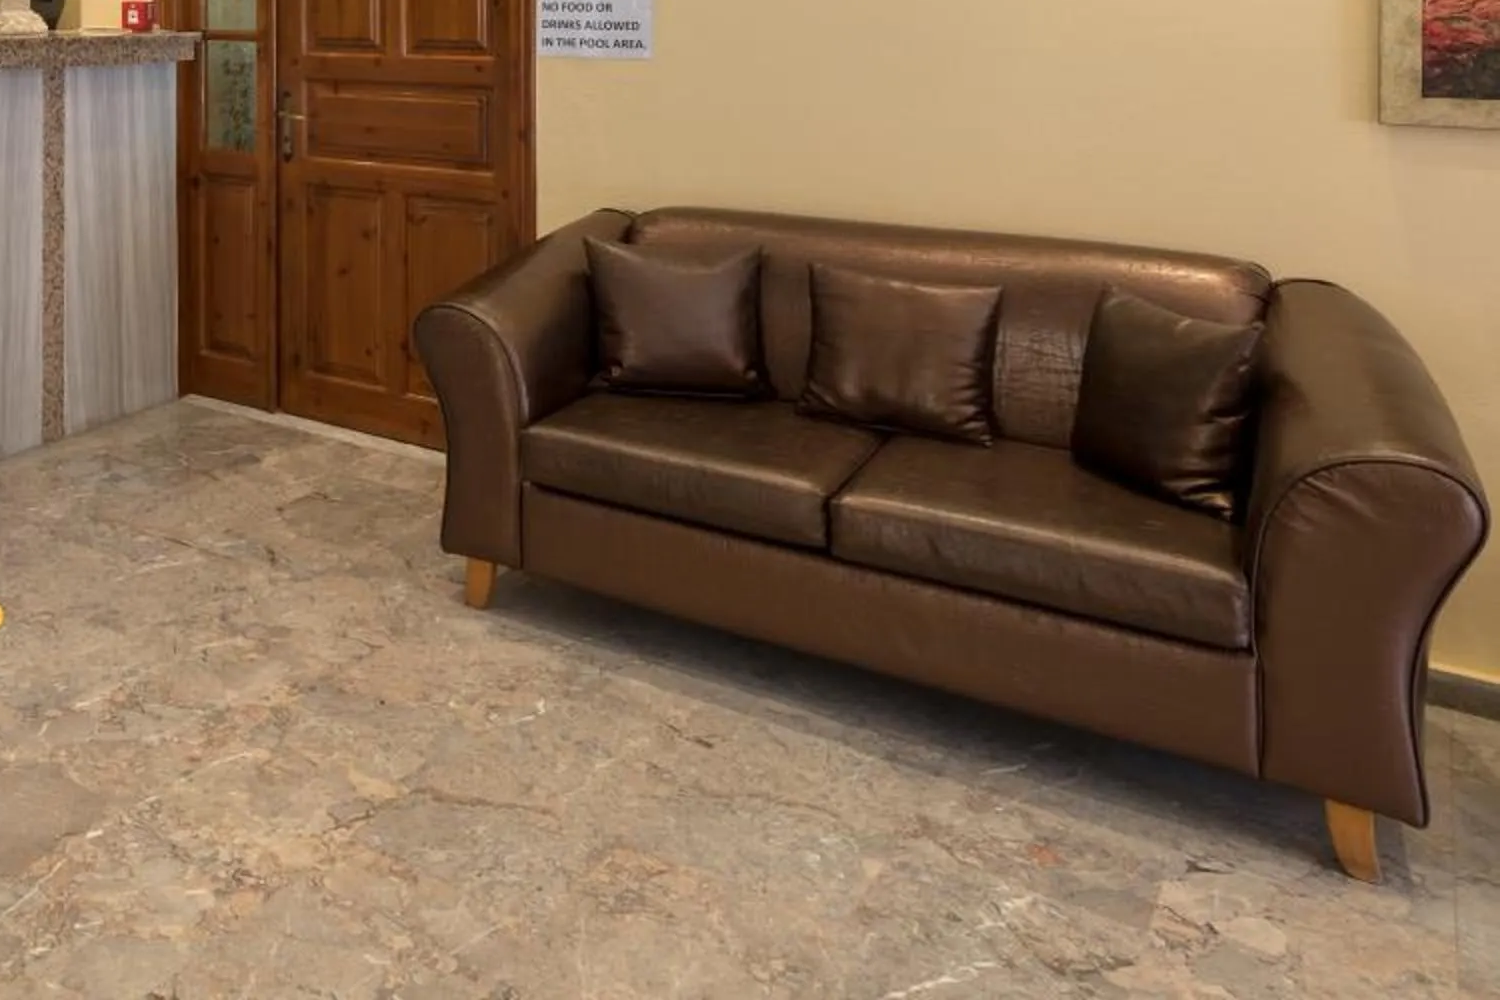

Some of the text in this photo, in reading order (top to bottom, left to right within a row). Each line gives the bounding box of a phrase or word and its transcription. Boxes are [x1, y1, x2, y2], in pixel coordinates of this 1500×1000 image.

[542, 1, 613, 13] NO FOOD OR
[541, 19, 641, 31] DRINKS ALLOWED
[541, 37, 553, 47] IN
[556, 38, 577, 48] THE
[579, 38, 610, 49] POOL
